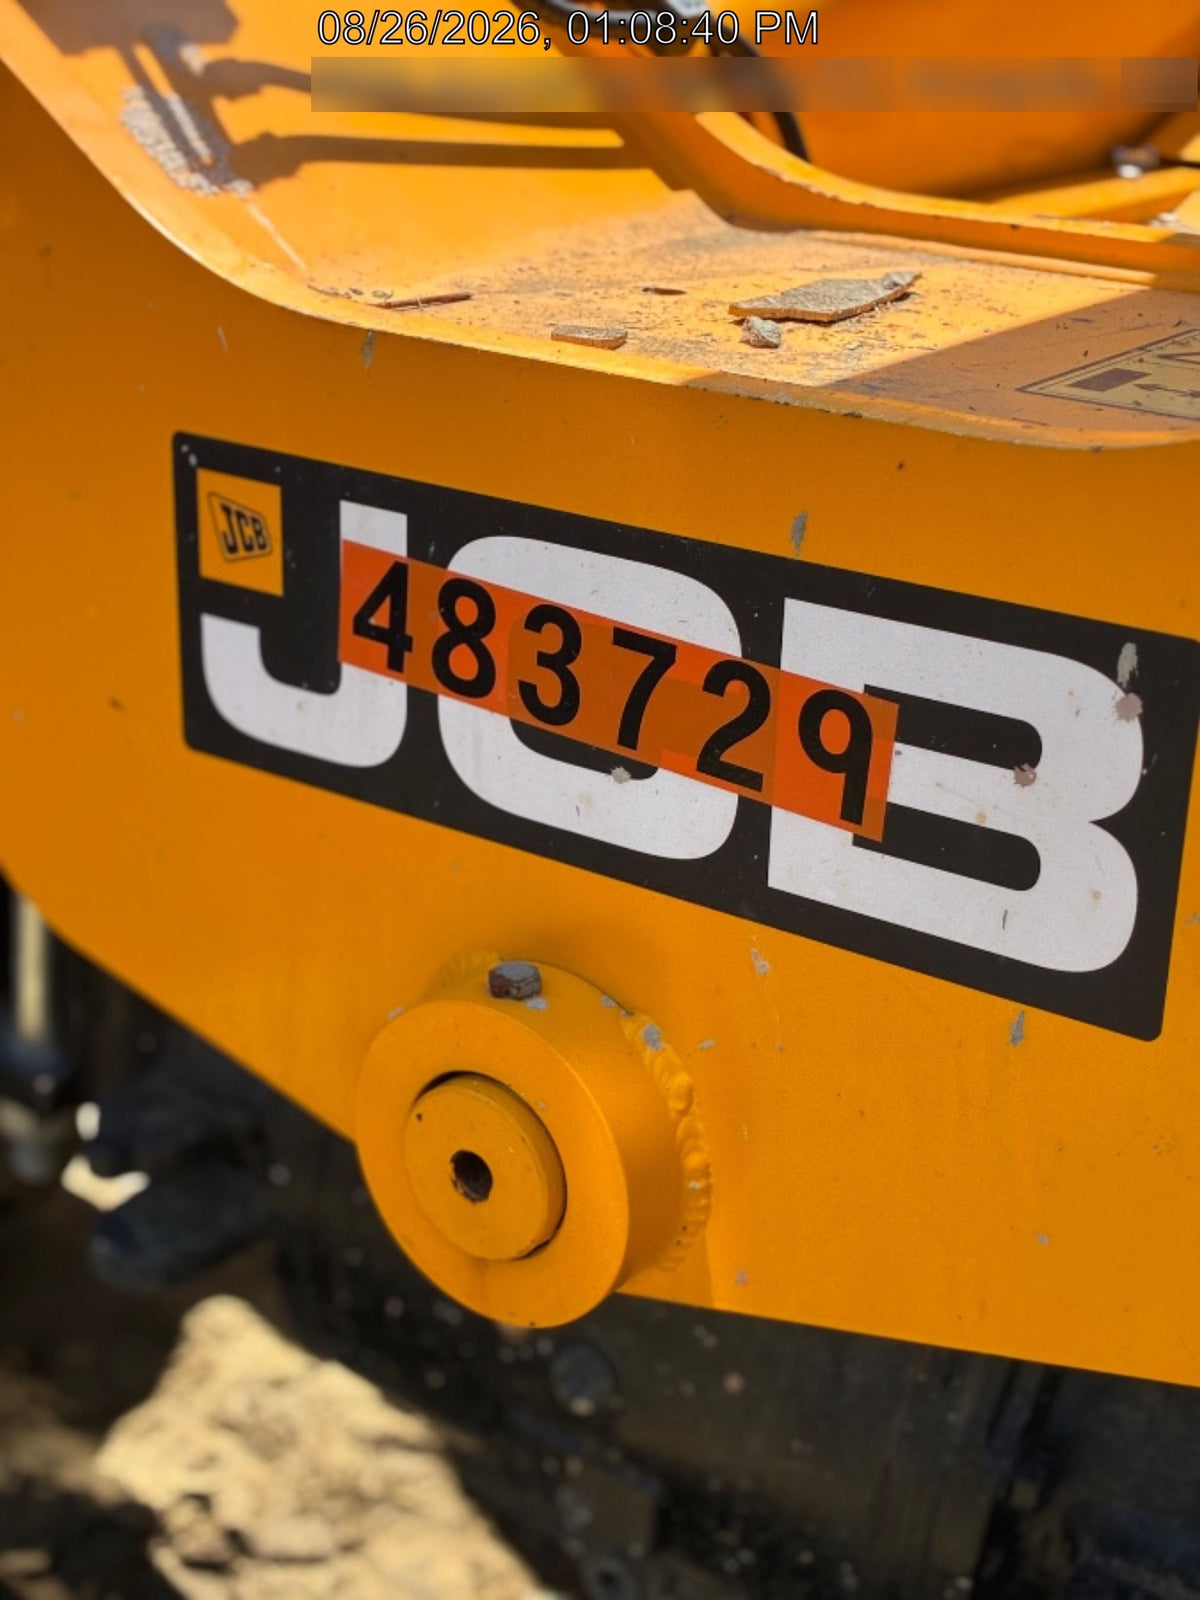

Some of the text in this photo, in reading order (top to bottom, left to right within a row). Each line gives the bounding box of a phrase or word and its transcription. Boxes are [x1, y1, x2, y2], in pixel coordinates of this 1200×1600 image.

[220, 502, 267, 554] JCB
[201, 500, 1144, 972] JCB
[352, 561, 873, 825] 483729
